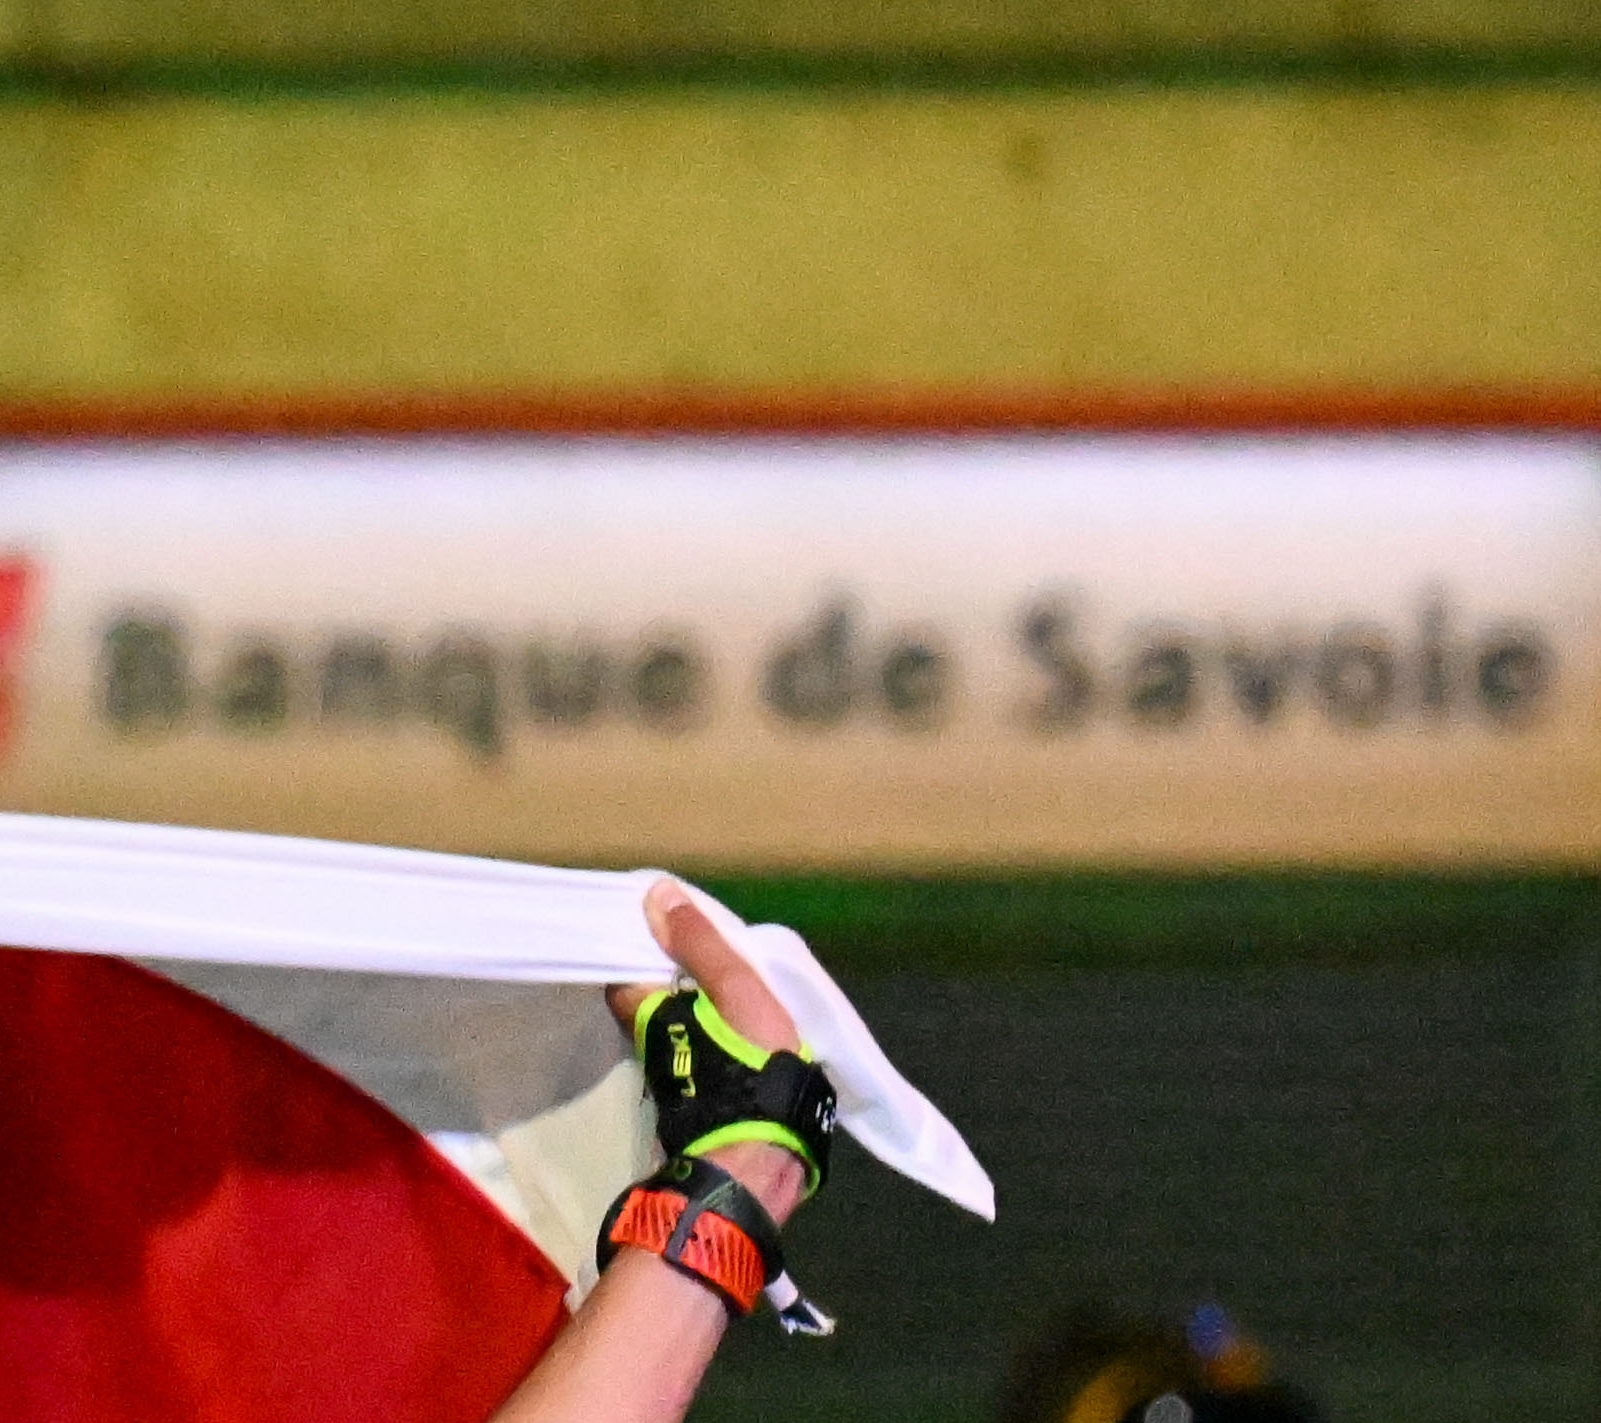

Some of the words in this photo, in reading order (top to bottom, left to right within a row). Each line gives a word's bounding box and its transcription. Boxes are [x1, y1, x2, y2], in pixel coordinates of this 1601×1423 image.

[98, 600, 704, 766] Banque
[760, 586, 950, 732] de
[1012, 586, 1552, 734] Savoie
